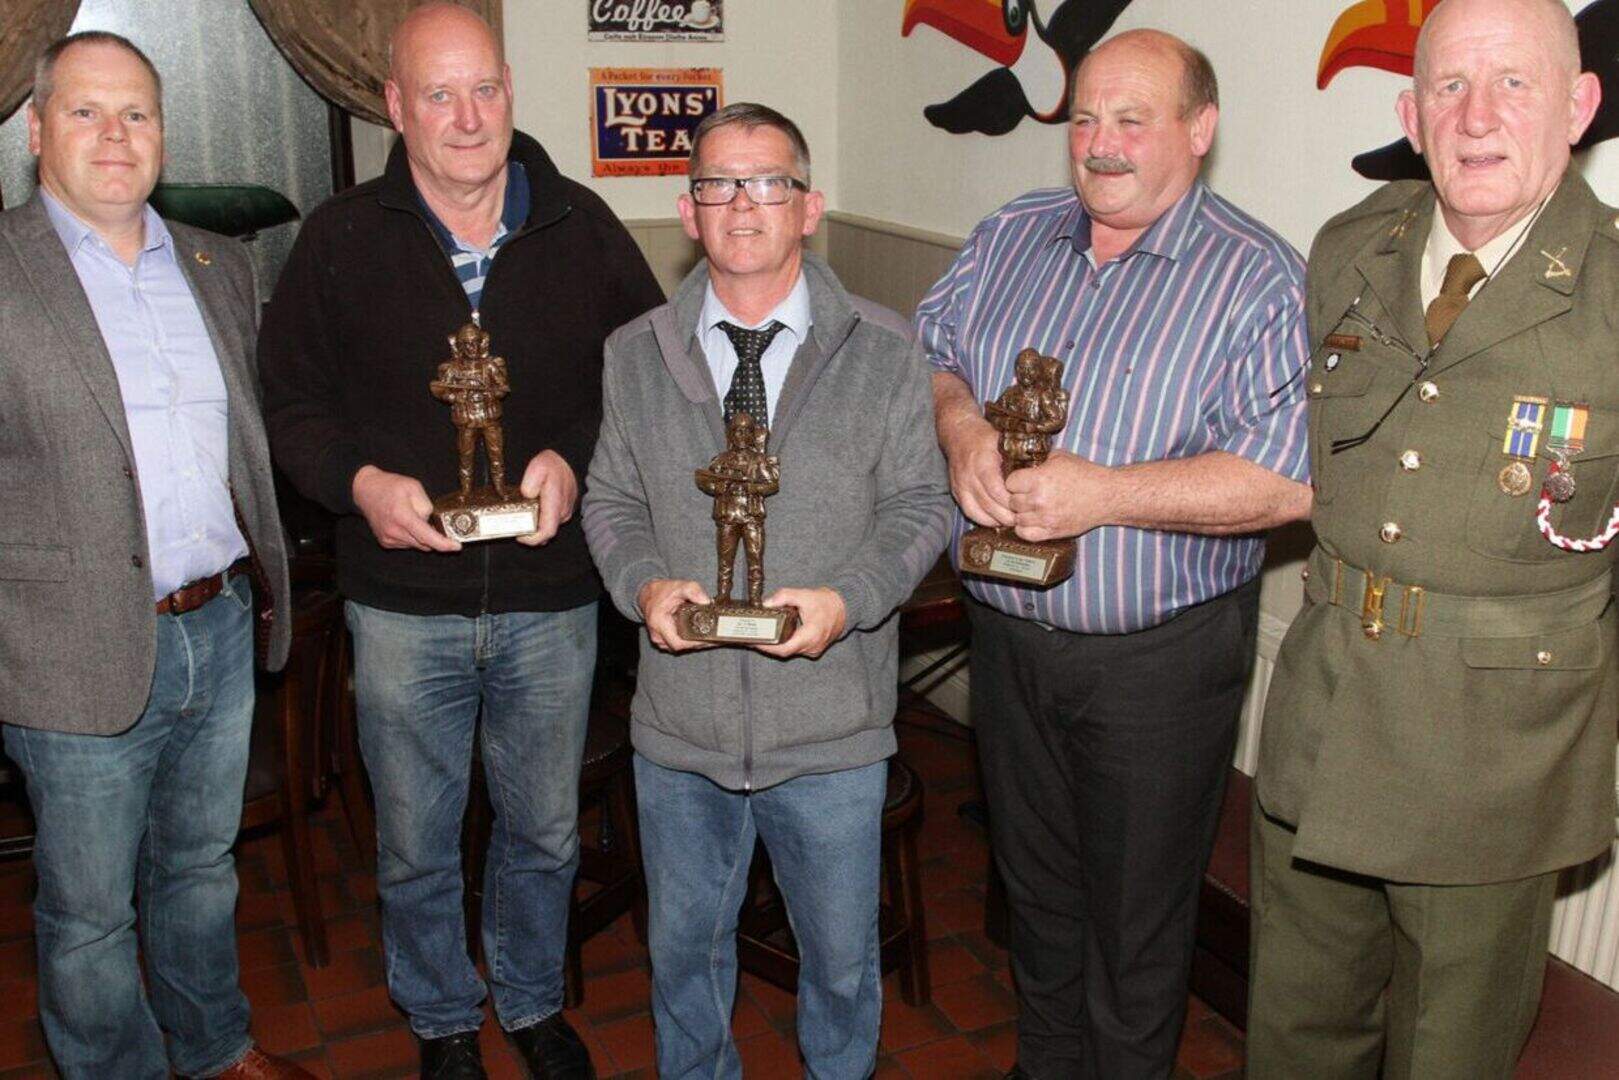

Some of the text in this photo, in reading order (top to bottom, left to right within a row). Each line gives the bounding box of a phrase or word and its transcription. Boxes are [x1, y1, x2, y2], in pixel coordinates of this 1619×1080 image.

[592, 0, 686, 31] Coffee
[655, 73, 681, 82] every
[620, 128, 692, 152] TEA
[604, 163, 650, 174] Always
